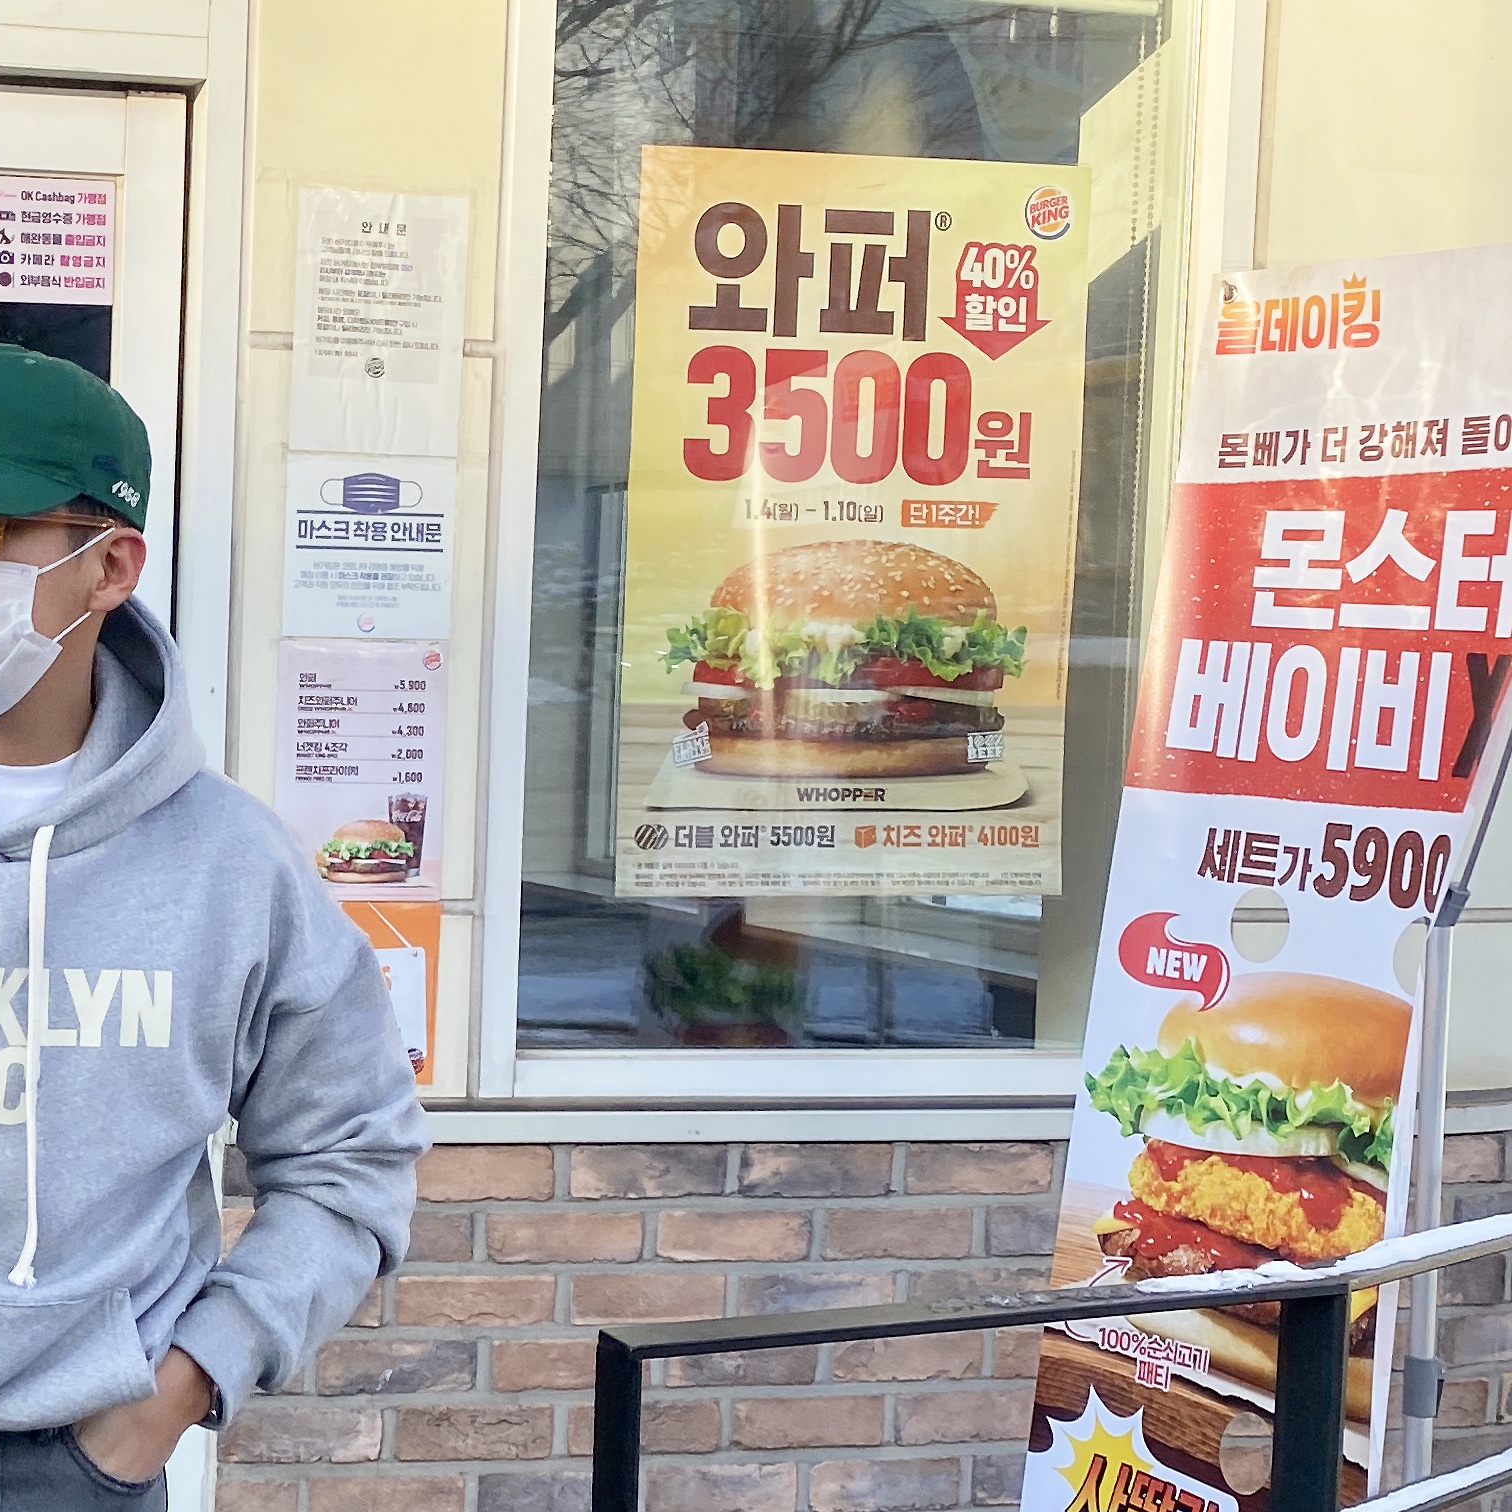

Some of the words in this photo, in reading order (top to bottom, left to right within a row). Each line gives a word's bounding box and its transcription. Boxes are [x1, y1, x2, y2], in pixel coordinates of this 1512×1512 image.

[20, 190, 34, 201] OK
[35, 191, 75, 204] Cashbag
[1029, 195, 1069, 214] BURGER
[1031, 205, 1070, 229] KING
[20, 253, 55, 266] 카메라
[960, 246, 1035, 289] 40%
[964, 294, 1027, 332] 할인
[683, 344, 1033, 486] 3500원
[1217, 425, 1311, 469] 몬베가
[1321, 426, 1349, 464] 더
[1358, 418, 1449, 462] 강해져
[298, 519, 350, 541] 마스크
[353, 521, 388, 542] 착용
[390, 522, 442, 543] 안내문
[796, 786, 886, 803] WHOPPER
[674, 825, 715, 849] 더블
[770, 825, 836, 848] 5500원
[882, 824, 922, 848] 치즈
[977, 825, 1040, 848] 4100원
[1146, 946, 1209, 984] NEW
[1134, 1361, 1171, 1391] 패티
